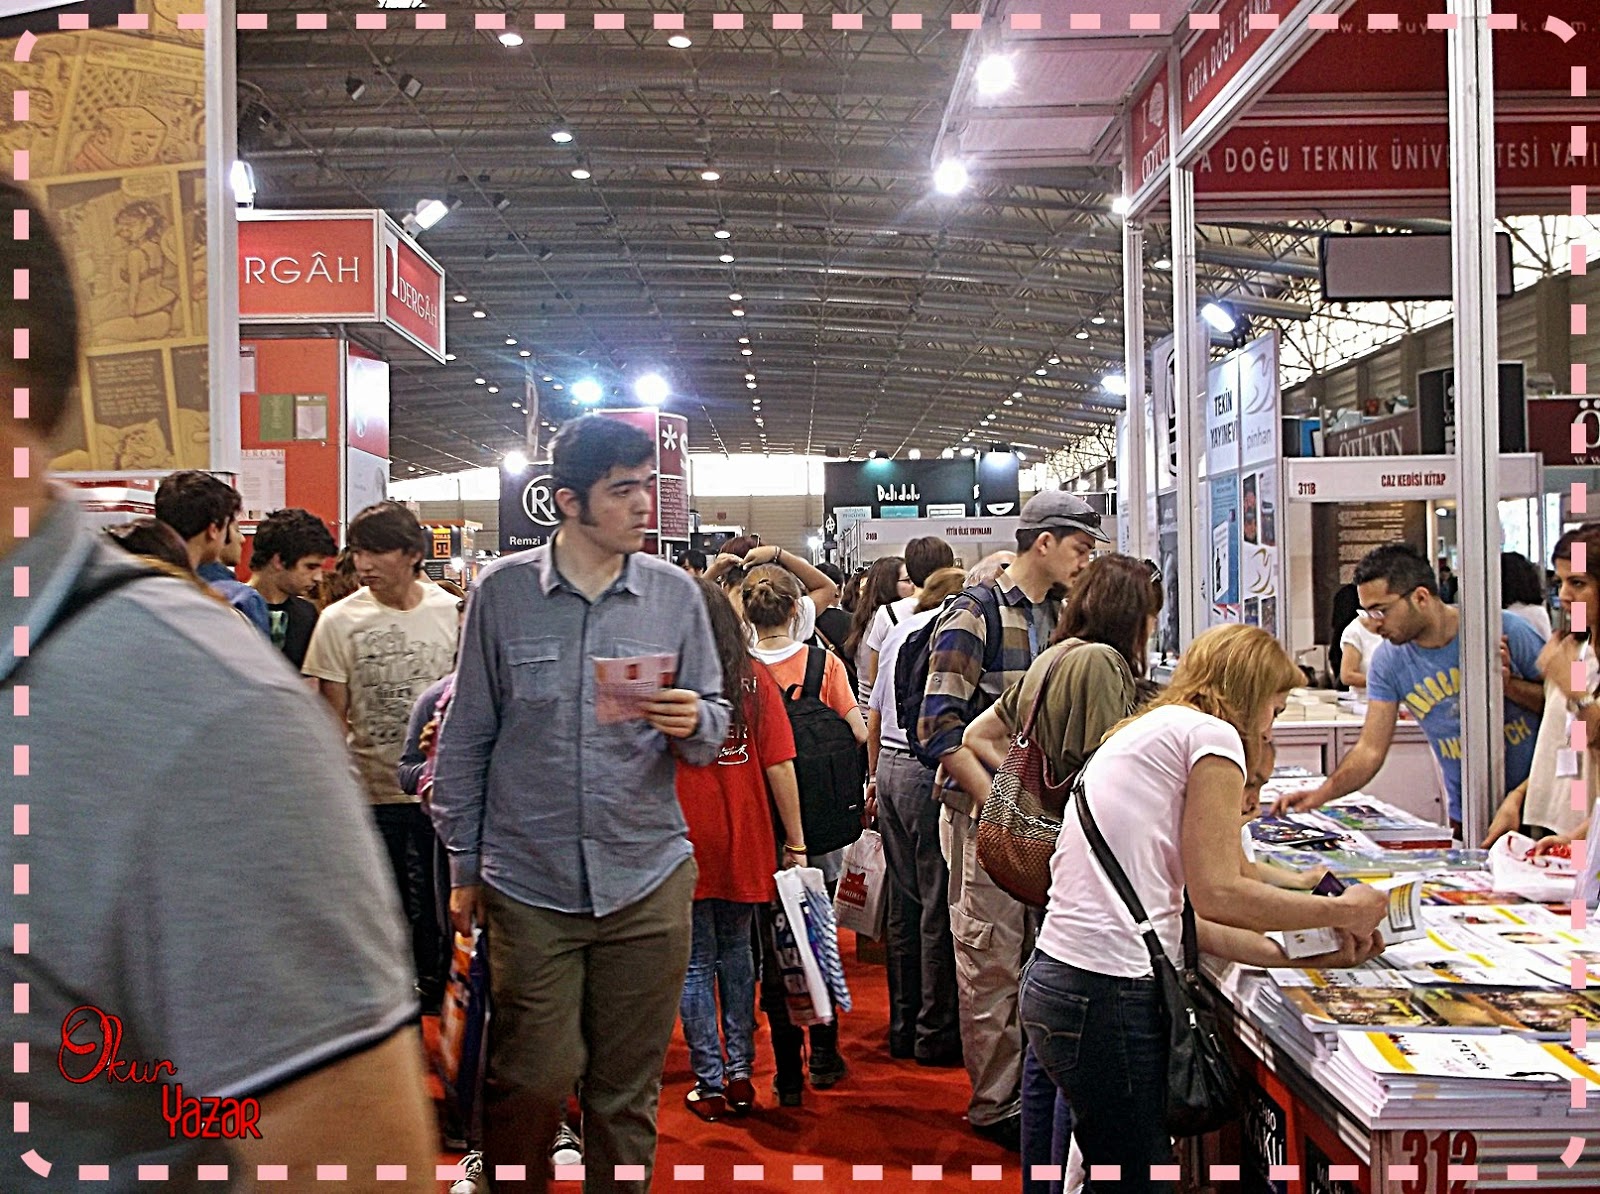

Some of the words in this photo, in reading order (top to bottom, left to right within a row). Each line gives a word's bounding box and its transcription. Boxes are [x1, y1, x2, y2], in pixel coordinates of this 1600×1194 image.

[1187, 57, 1208, 102] ORTA
[1210, 21, 1235, 78] DOĞU
[1142, 128, 1168, 183] ODTÜ
[1225, 139, 1289, 172] DOĞU
[1302, 139, 1379, 172] TEKNİK
[244, 252, 360, 284] RGÂH
[398, 277, 438, 328] DERGÂH
[1214, 387, 1233, 417] TEKİN
[1210, 416, 1238, 449] YAYINEVİ
[1246, 427, 1272, 449] pinhan
[1339, 426, 1404, 456] ÖTÜKEN
[876, 483, 920, 501] Delidolu
[1298, 482, 1316, 495] 311B
[1381, 474, 1396, 487] CAZ
[1397, 471, 1422, 486] KEDİSİ
[1424, 469, 1446, 485] KİTAP
[509, 536, 541, 545] Remzi
[1402, 1129, 1477, 1194] 312
